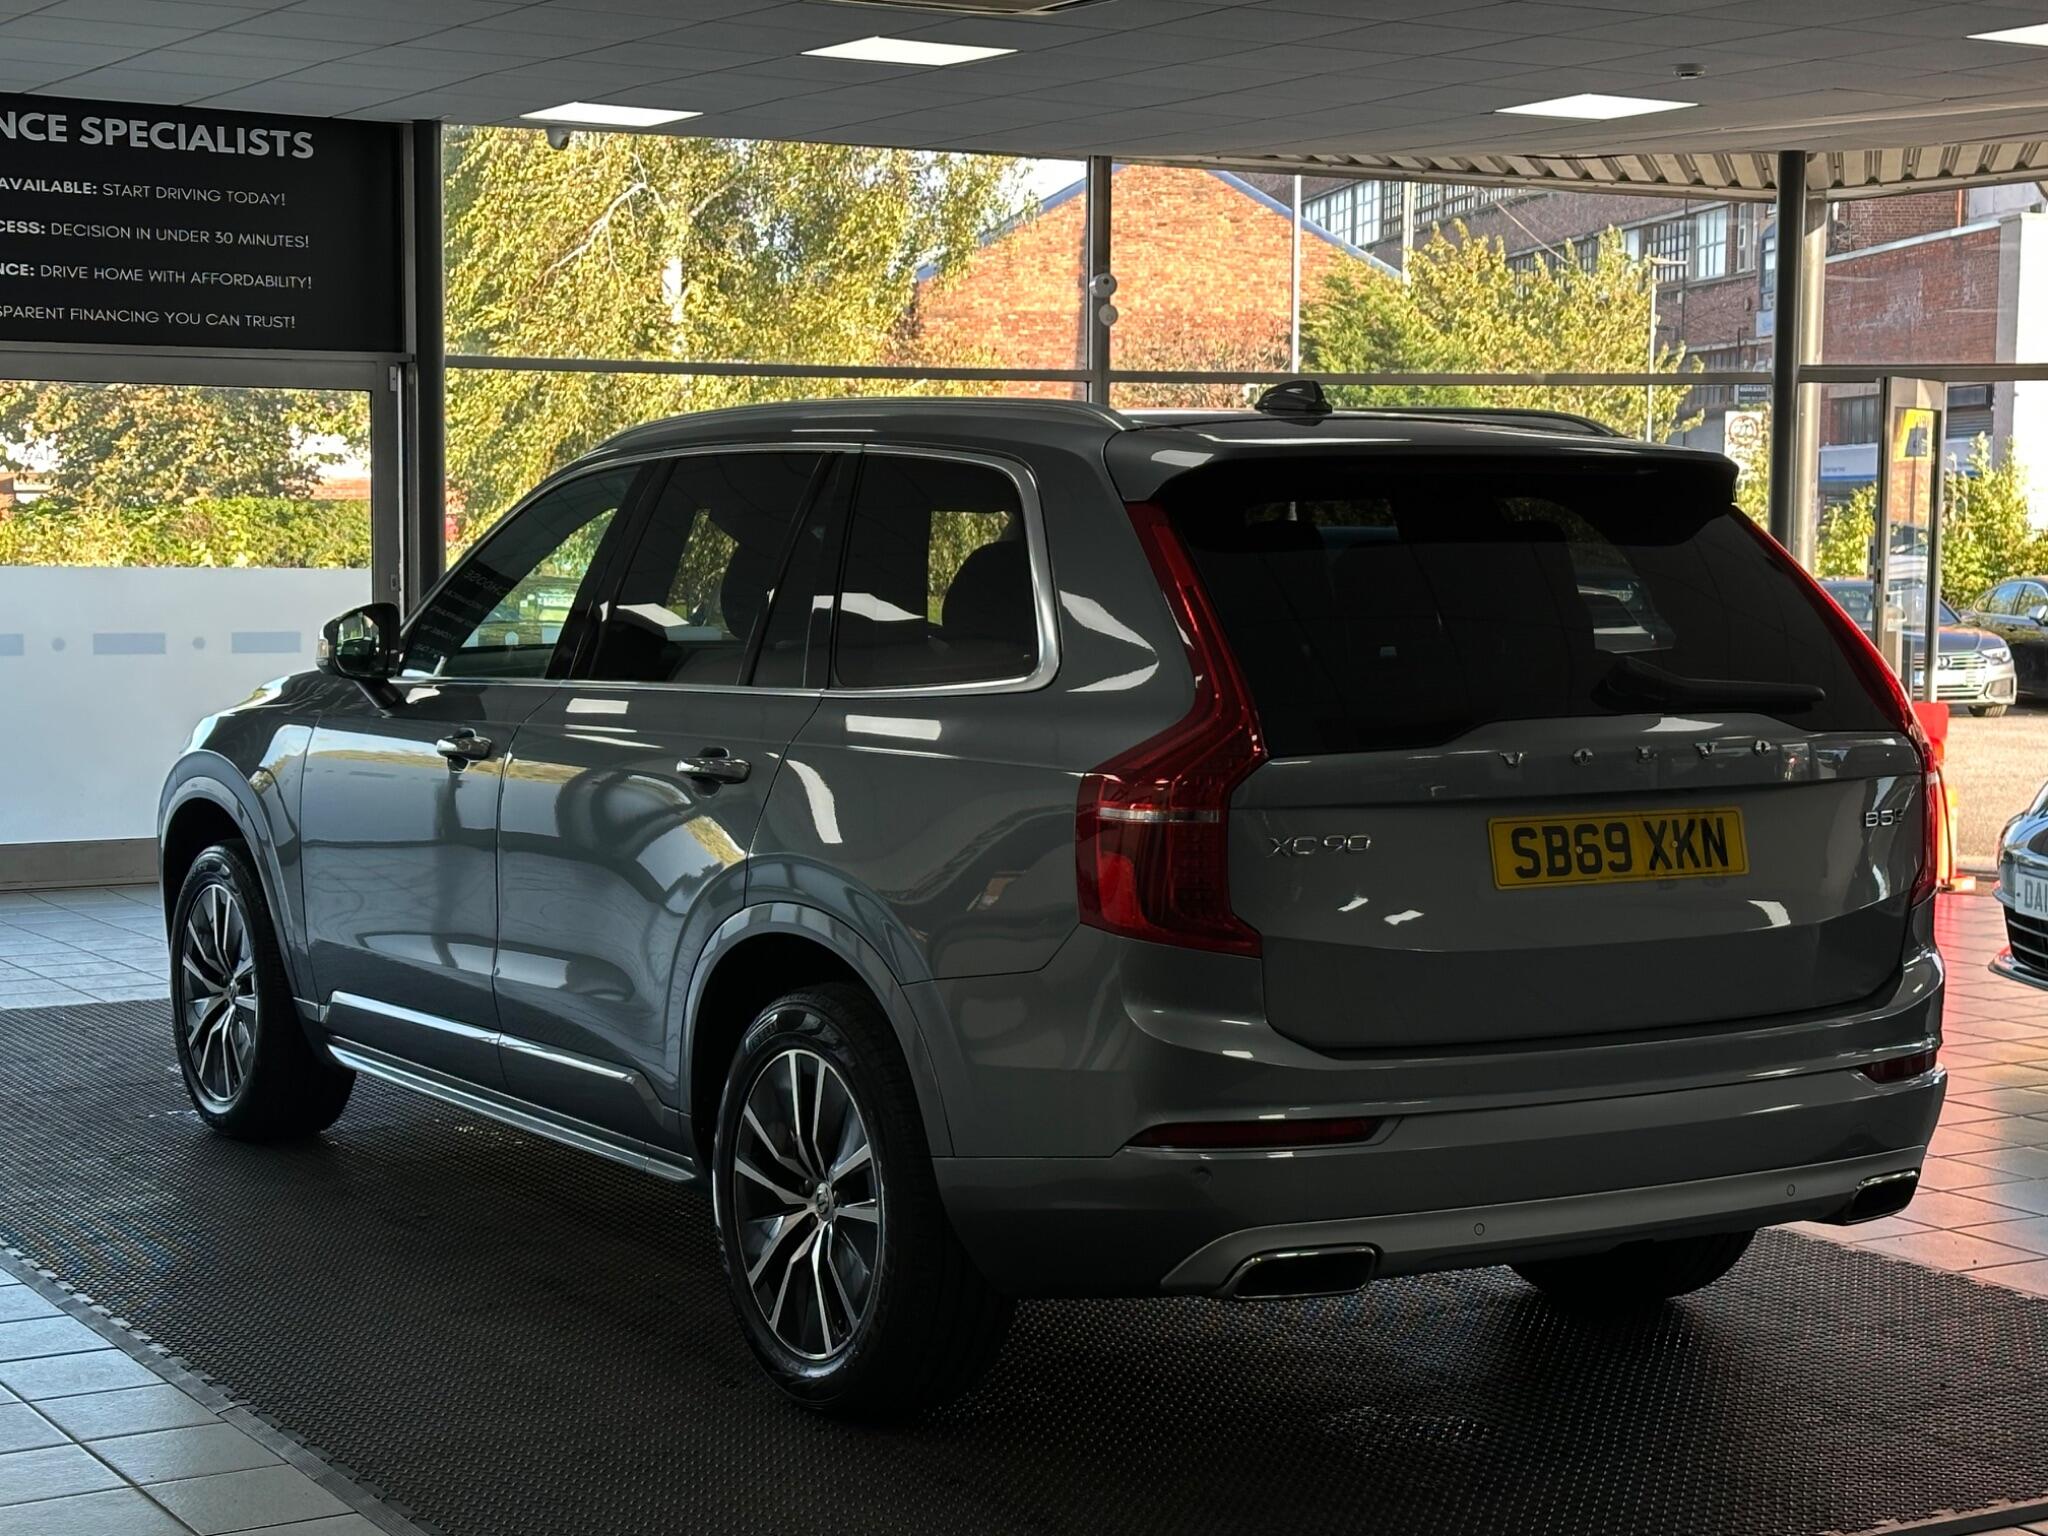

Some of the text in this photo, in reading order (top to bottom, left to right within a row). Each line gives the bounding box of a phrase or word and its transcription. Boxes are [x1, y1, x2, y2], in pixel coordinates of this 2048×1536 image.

[79, 116, 315, 159] SPECIALISTS
[0, 177, 286, 206] AVAILABLE: START DRIVING TODAY!
[51, 222, 131, 239] DECISION
[136, 227, 151, 240] IN
[155, 229, 210, 243] UNDER
[214, 232, 234, 245] 30
[237, 233, 309, 248] MINUTES!
[40, 265, 89, 279] DRIVE
[94, 267, 143, 282] HOME
[148, 270, 186, 284] WITH
[191, 271, 312, 290] AFFORDABILITY!
[70, 308, 160, 324] FINANCING
[164, 311, 201, 325] YOU
[205, 314, 240, 327] CAN
[245, 315, 296, 329] TRUST!
[1500, 739, 1772, 768] VOLVO
[1511, 816, 1729, 879] SB69 XKN
[2024, 879, 2048, 913] DA
